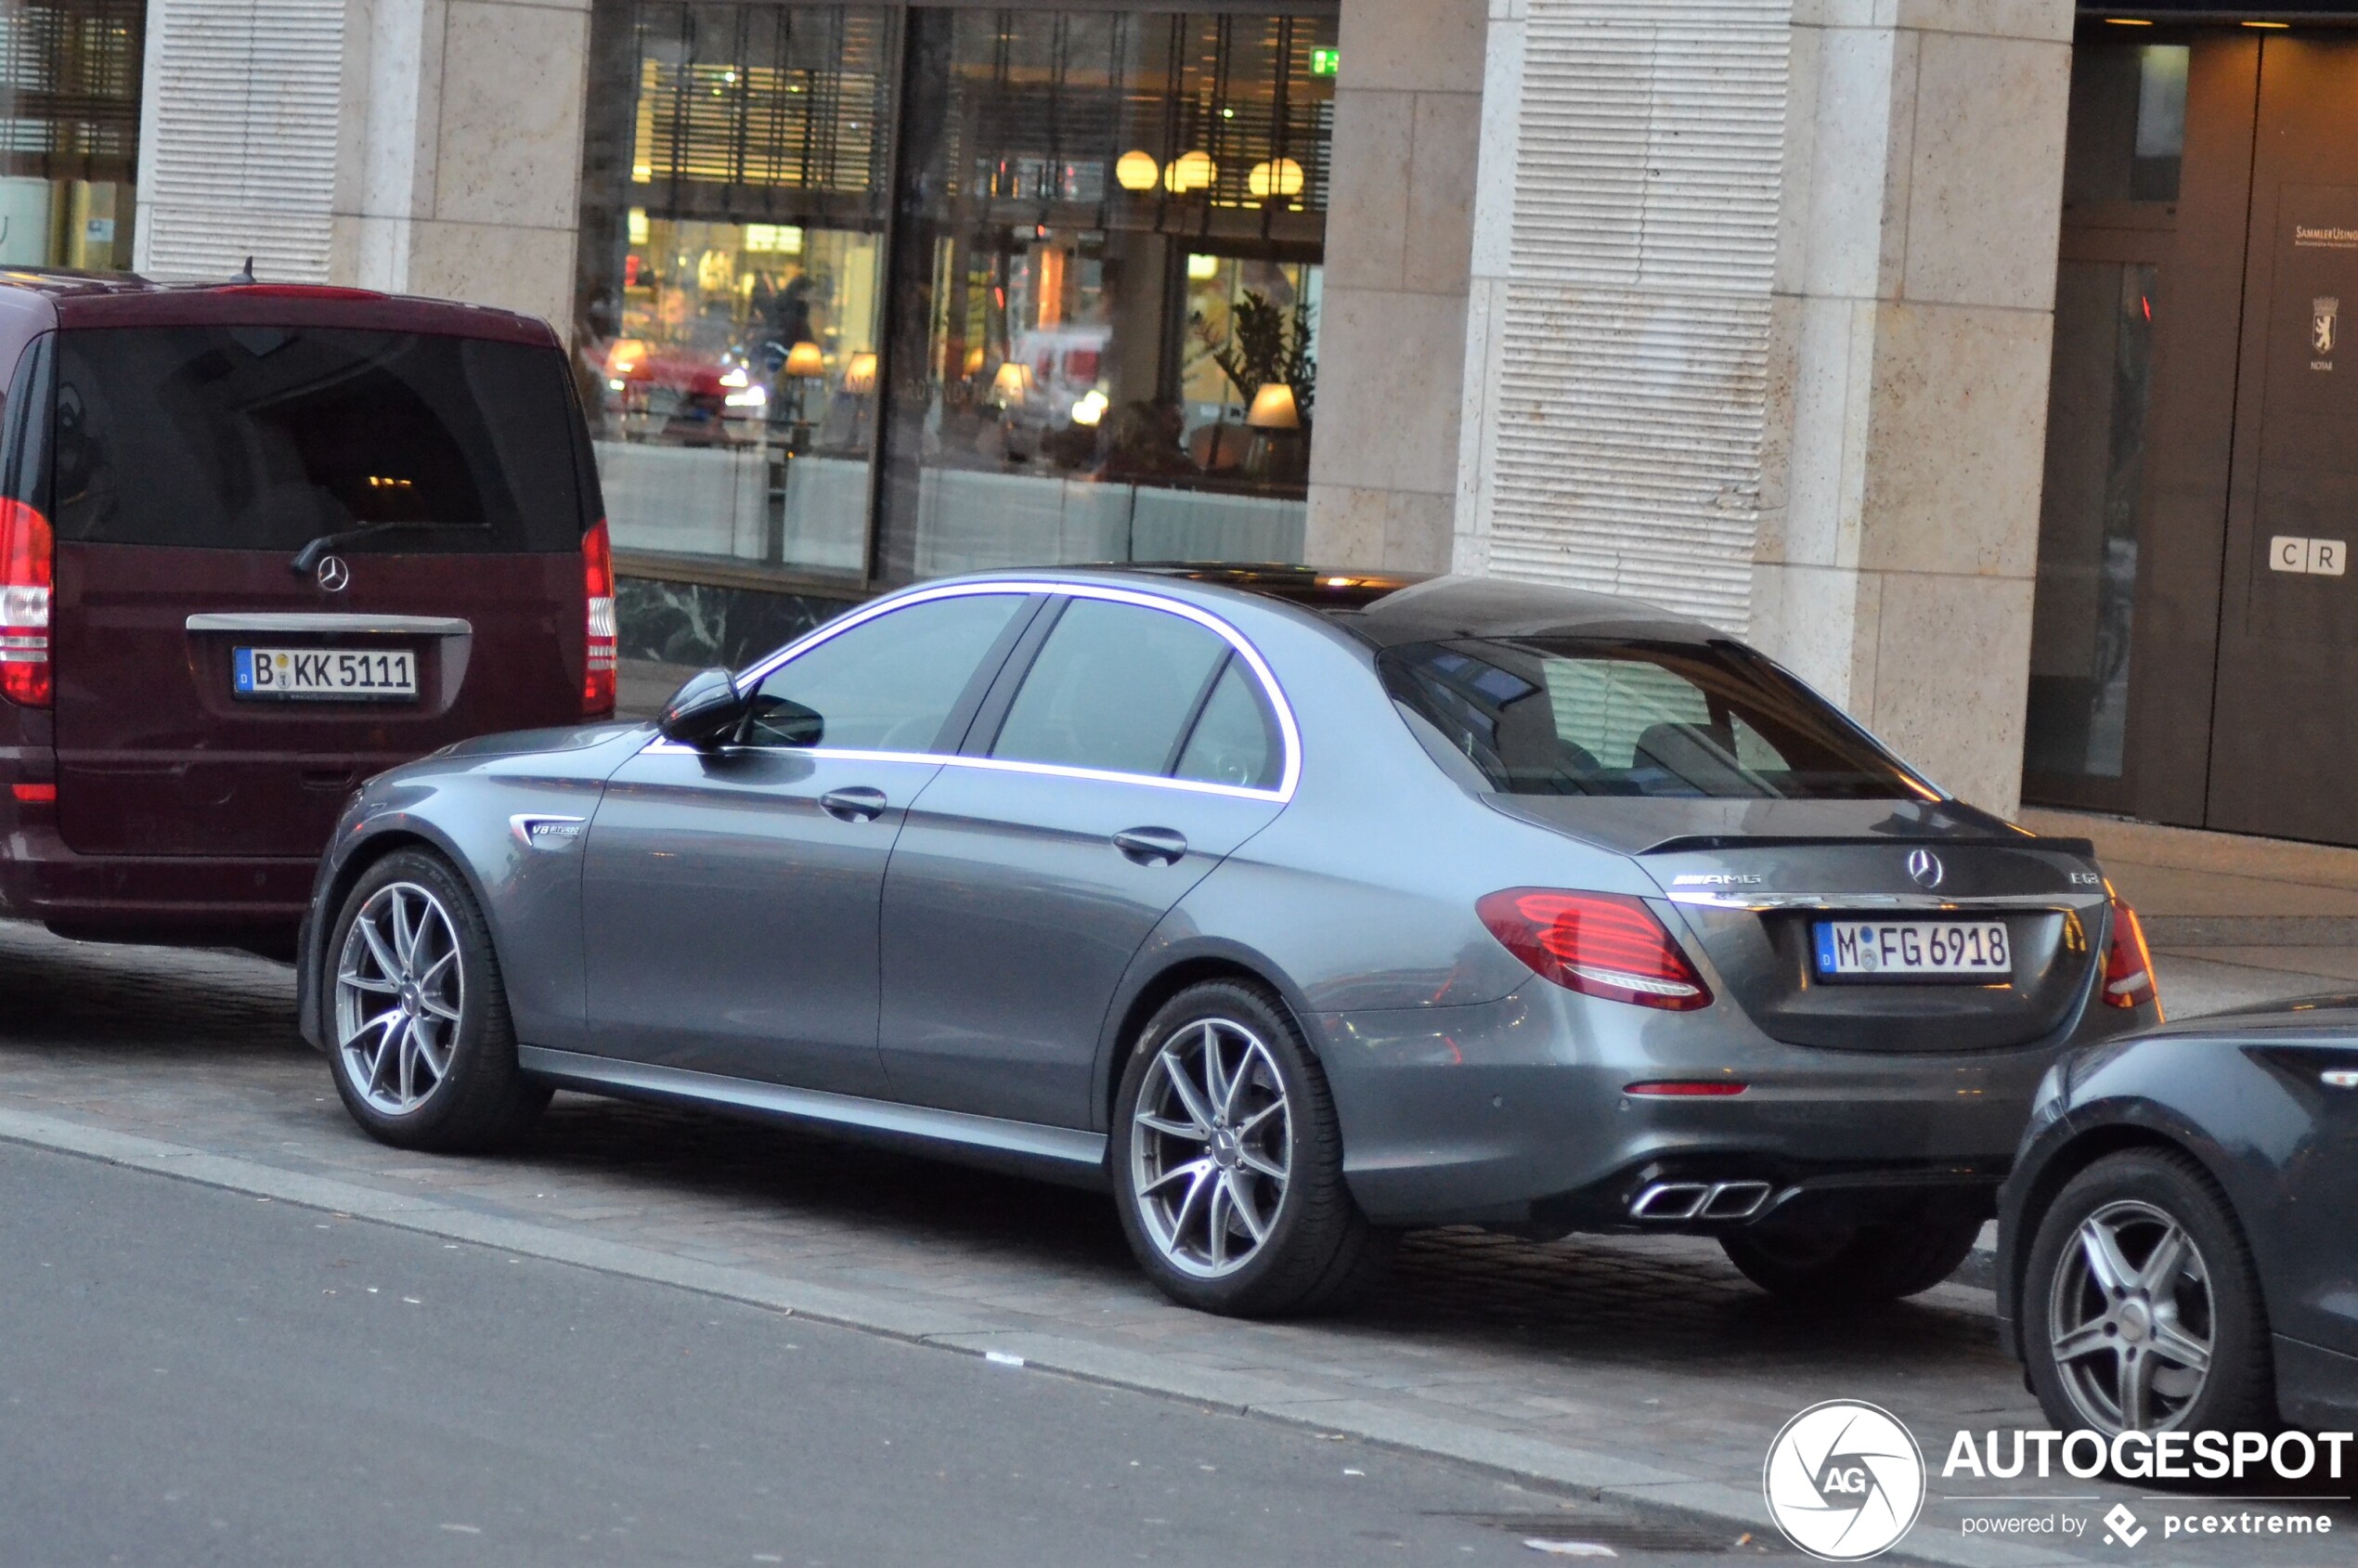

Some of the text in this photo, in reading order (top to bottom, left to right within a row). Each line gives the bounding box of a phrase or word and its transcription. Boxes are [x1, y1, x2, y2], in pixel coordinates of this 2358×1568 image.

[2282, 543, 2334, 568] C R
[255, 654, 411, 688] B KK 5111
[240, 674, 248, 684] D
[532, 825, 579, 835] V8 BITURBO
[1702, 874, 1761, 885] AMG
[1836, 927, 2006, 966] M FG 6918
[1823, 953, 1830, 965] D
